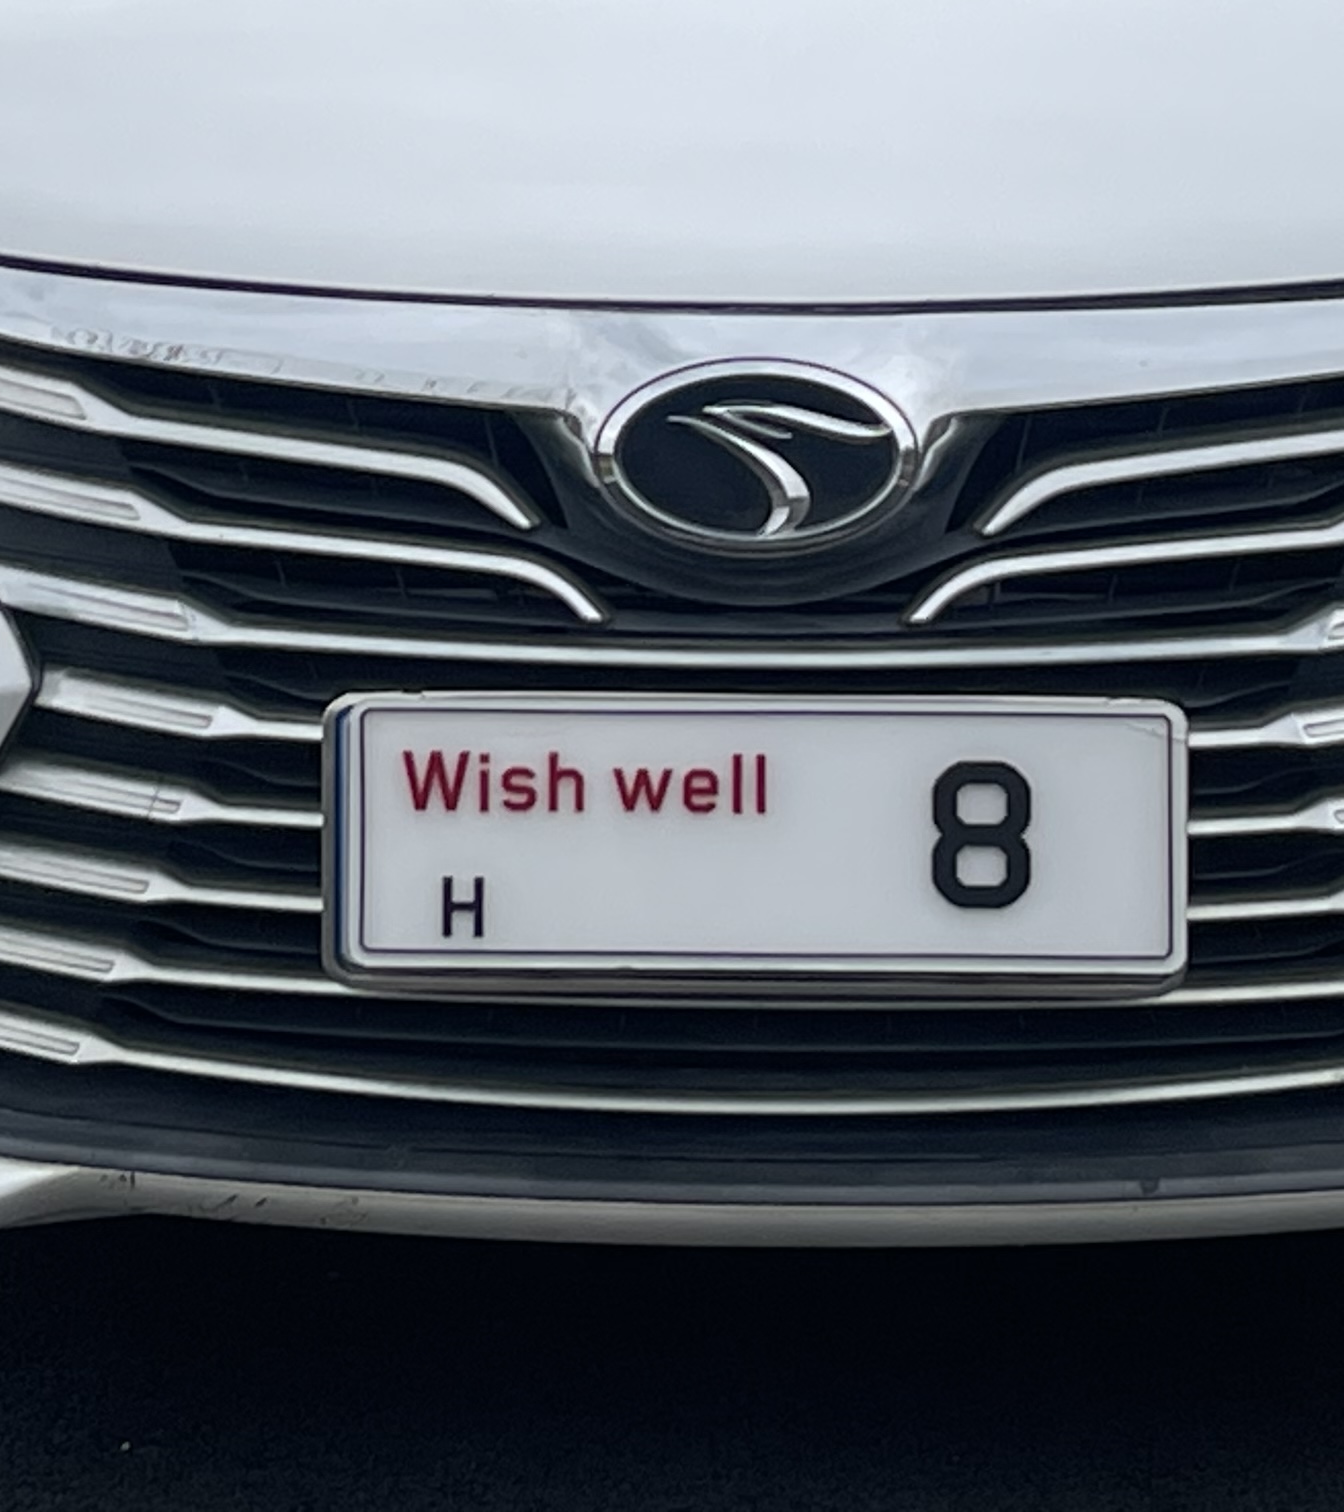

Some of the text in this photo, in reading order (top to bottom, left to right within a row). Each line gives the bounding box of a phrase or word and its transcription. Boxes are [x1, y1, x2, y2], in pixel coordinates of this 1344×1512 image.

[402, 749, 767, 816] Wish well
[930, 760, 1033, 912] 8
[441, 875, 485, 939] H
